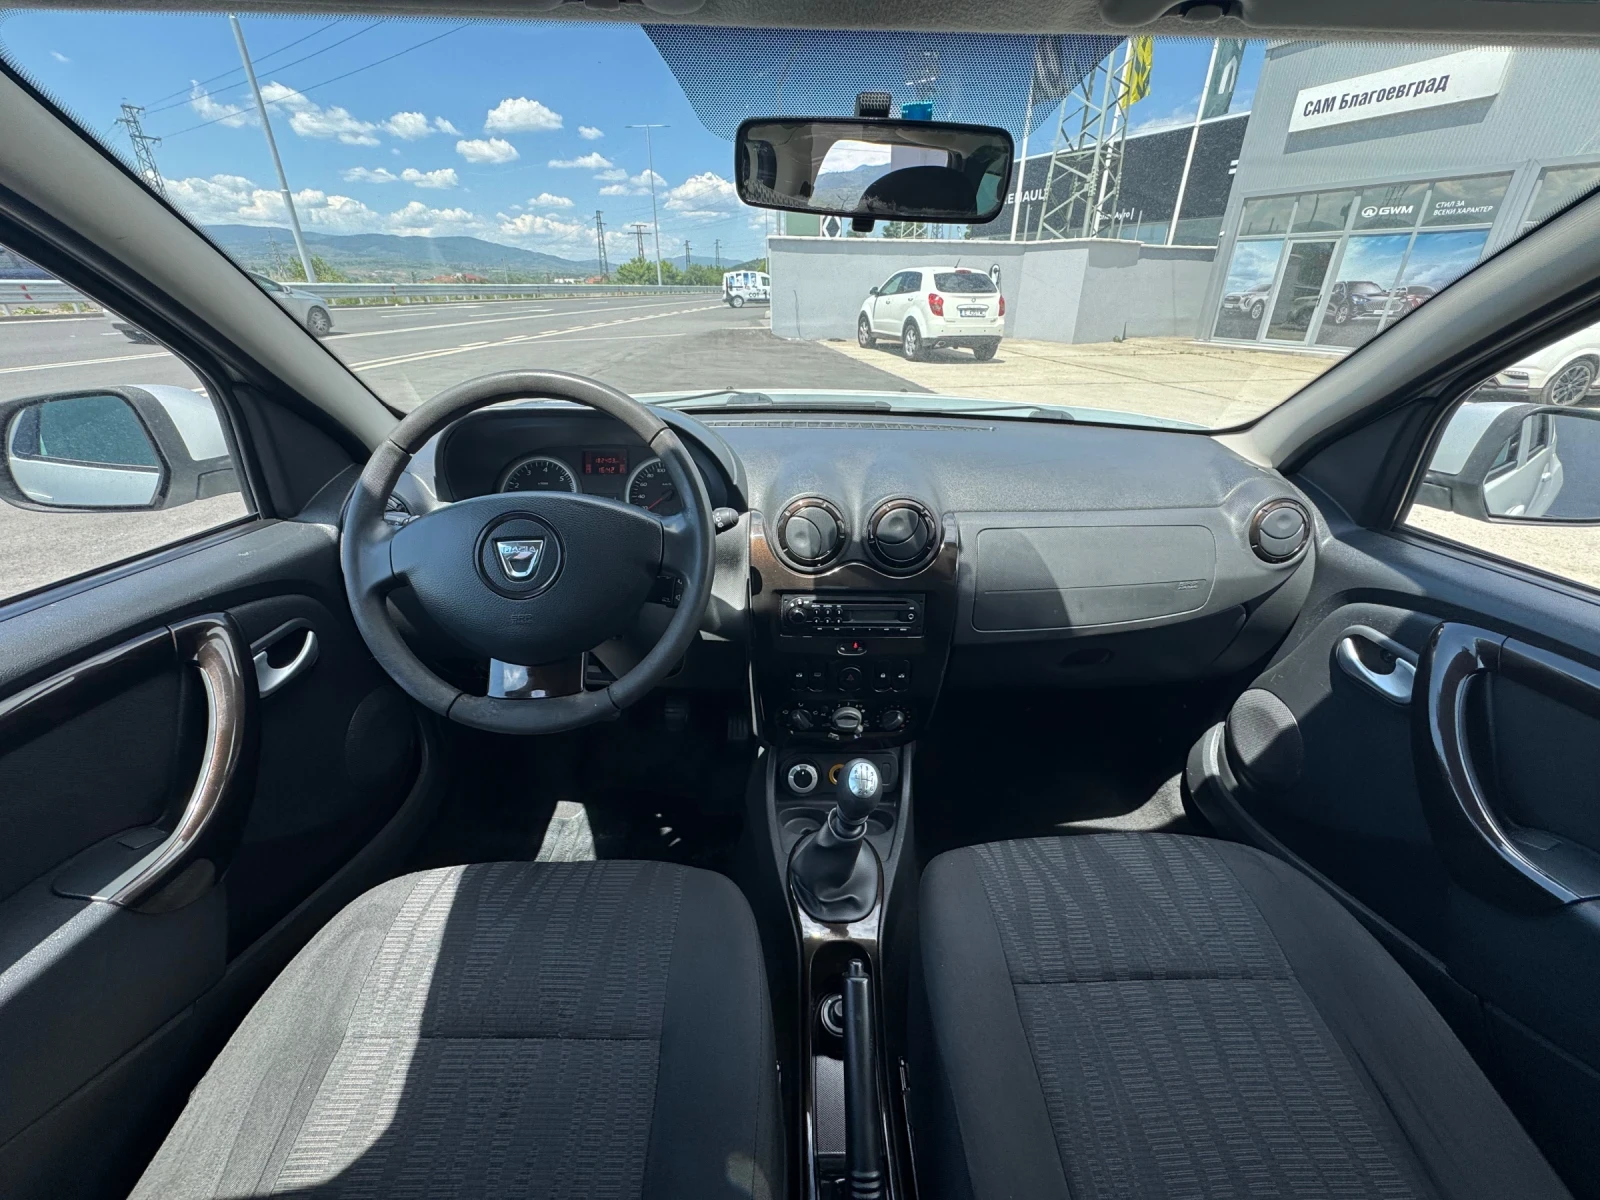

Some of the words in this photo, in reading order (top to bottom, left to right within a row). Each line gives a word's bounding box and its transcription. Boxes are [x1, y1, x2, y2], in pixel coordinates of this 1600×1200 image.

[1303, 96, 1337, 117] САМ
[1338, 74, 1451, 110] Благоевград
[1004, 187, 1052, 205] EAUL
[1379, 205, 1414, 215] GWM
[1435, 201, 1455, 209] СТИЛ
[1457, 206, 1494, 214] ХАРАКТЕР
